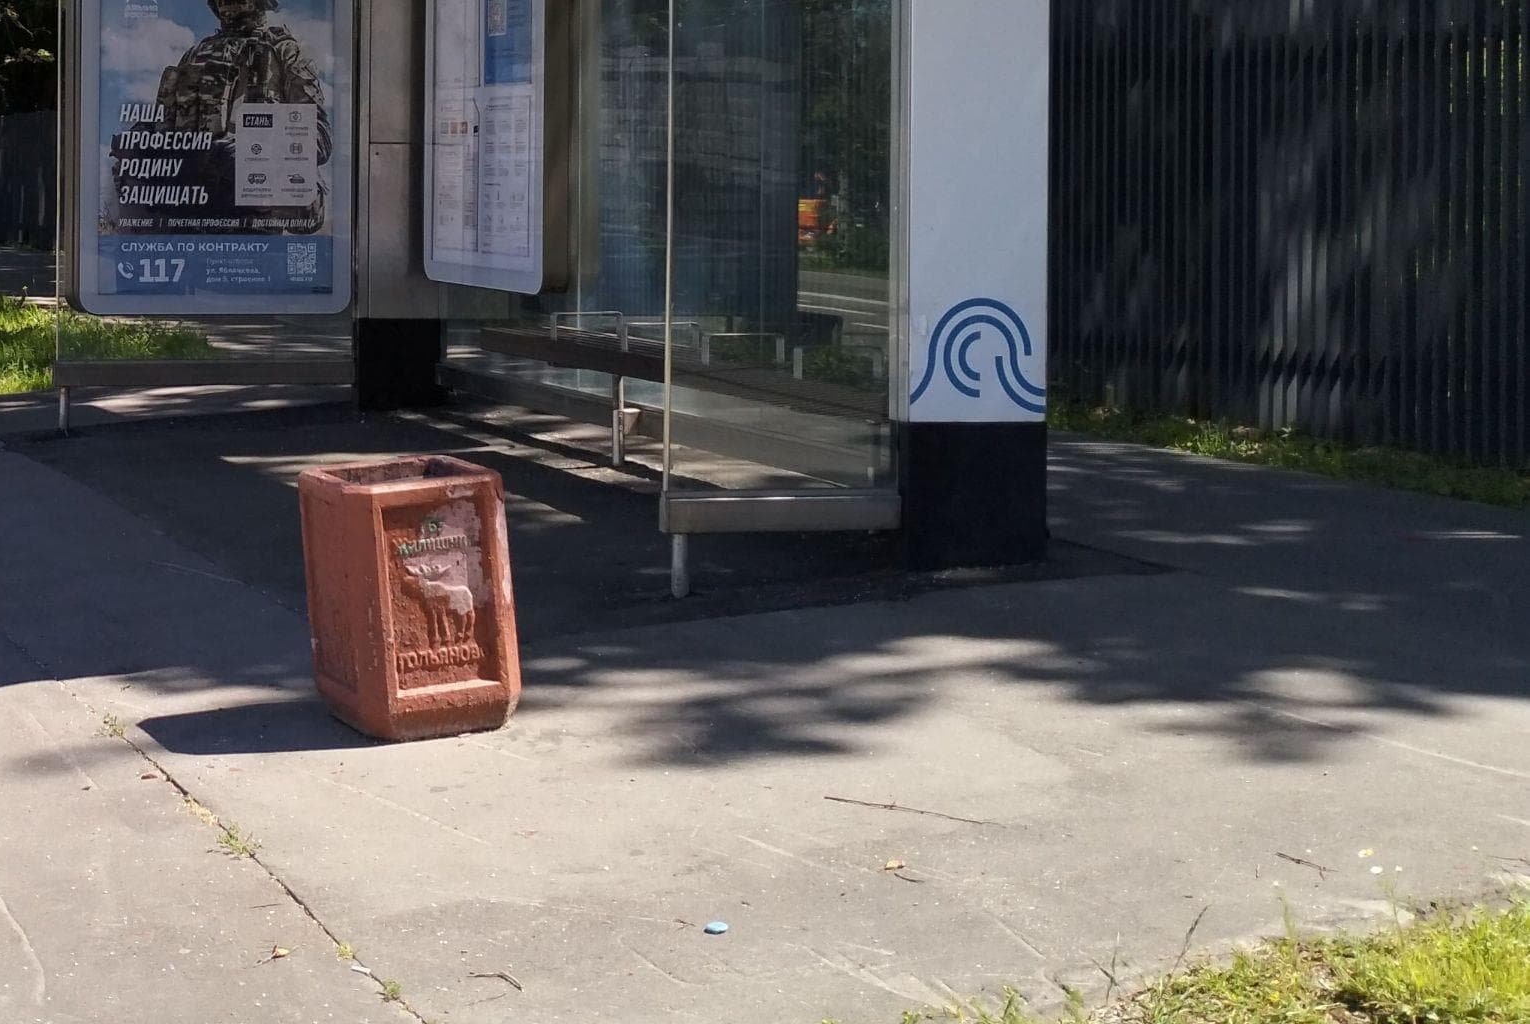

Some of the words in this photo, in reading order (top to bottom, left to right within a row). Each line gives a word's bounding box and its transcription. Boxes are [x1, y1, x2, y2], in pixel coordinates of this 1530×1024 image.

[119, 104, 165, 123] НАША
[119, 131, 213, 150] ПРОФЕССИЯ
[119, 158, 183, 179] РОДИНУ
[119, 185, 209, 207] ЗАЩИЩАТЬ
[118, 218, 154, 227] УВАЖЕНИЕ
[201, 218, 240, 227] ПРОФЕССИЯ
[120, 242, 174, 252] СЛУЖБА
[177, 243, 195, 252] ПО
[198, 242, 269, 252] КОНТРАКТУ
[139, 258, 186, 283] 117
